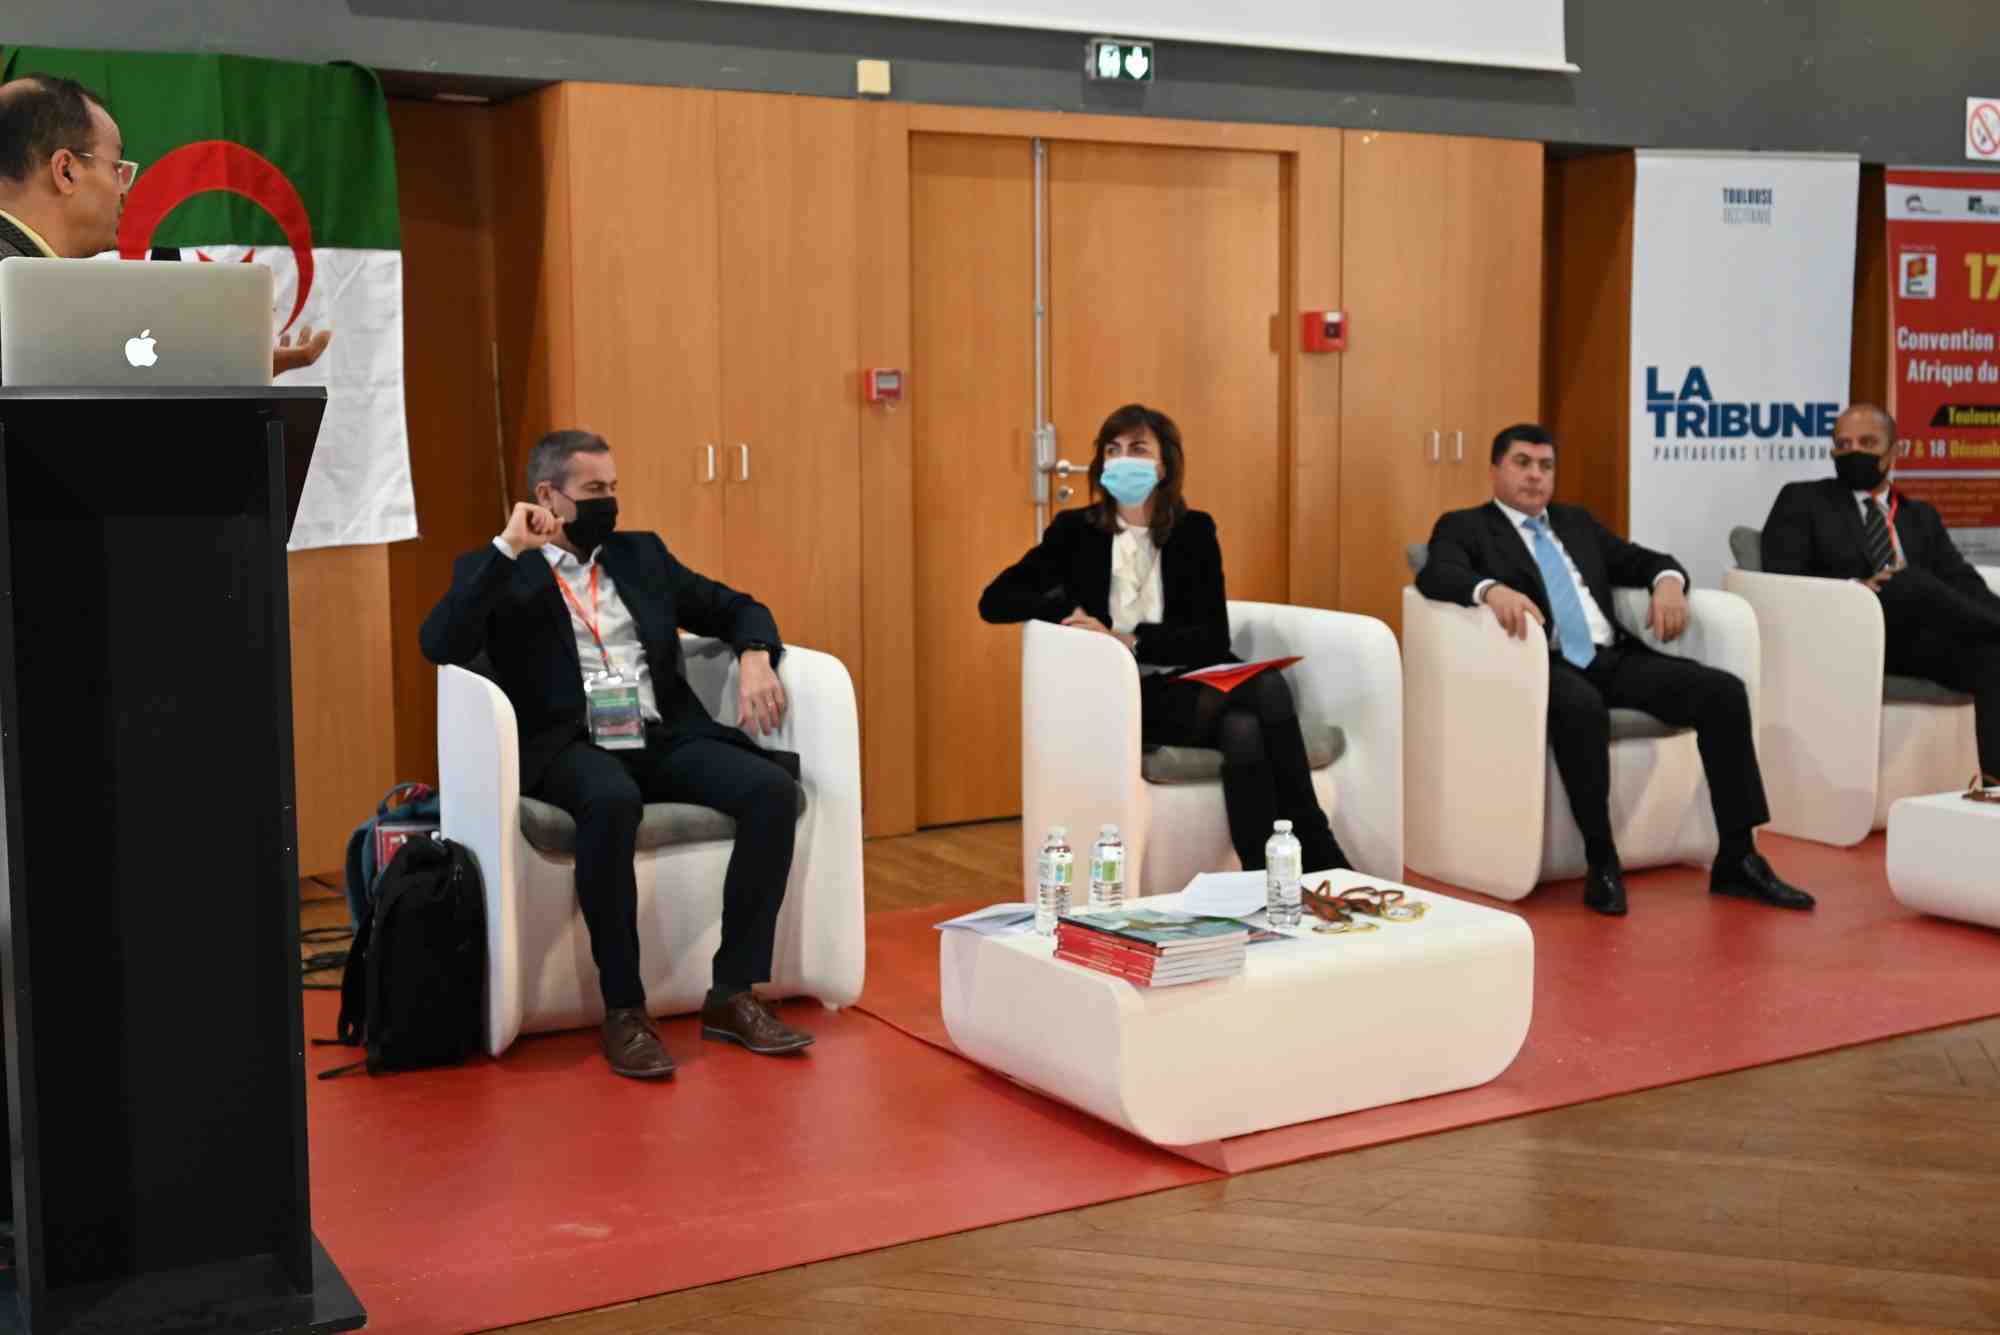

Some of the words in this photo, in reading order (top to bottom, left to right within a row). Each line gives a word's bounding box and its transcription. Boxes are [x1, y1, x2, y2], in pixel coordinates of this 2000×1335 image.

[1964, 252, 2000, 300] 17
[1897, 326, 1994, 351] Convention
[1646, 366, 1713, 401] LA
[1907, 358, 1973, 389] Afrique
[1978, 358, 1999, 384] du
[1647, 403, 1839, 438] TRIBUNE
[1755, 442, 1828, 461] L'ÉCONOM
